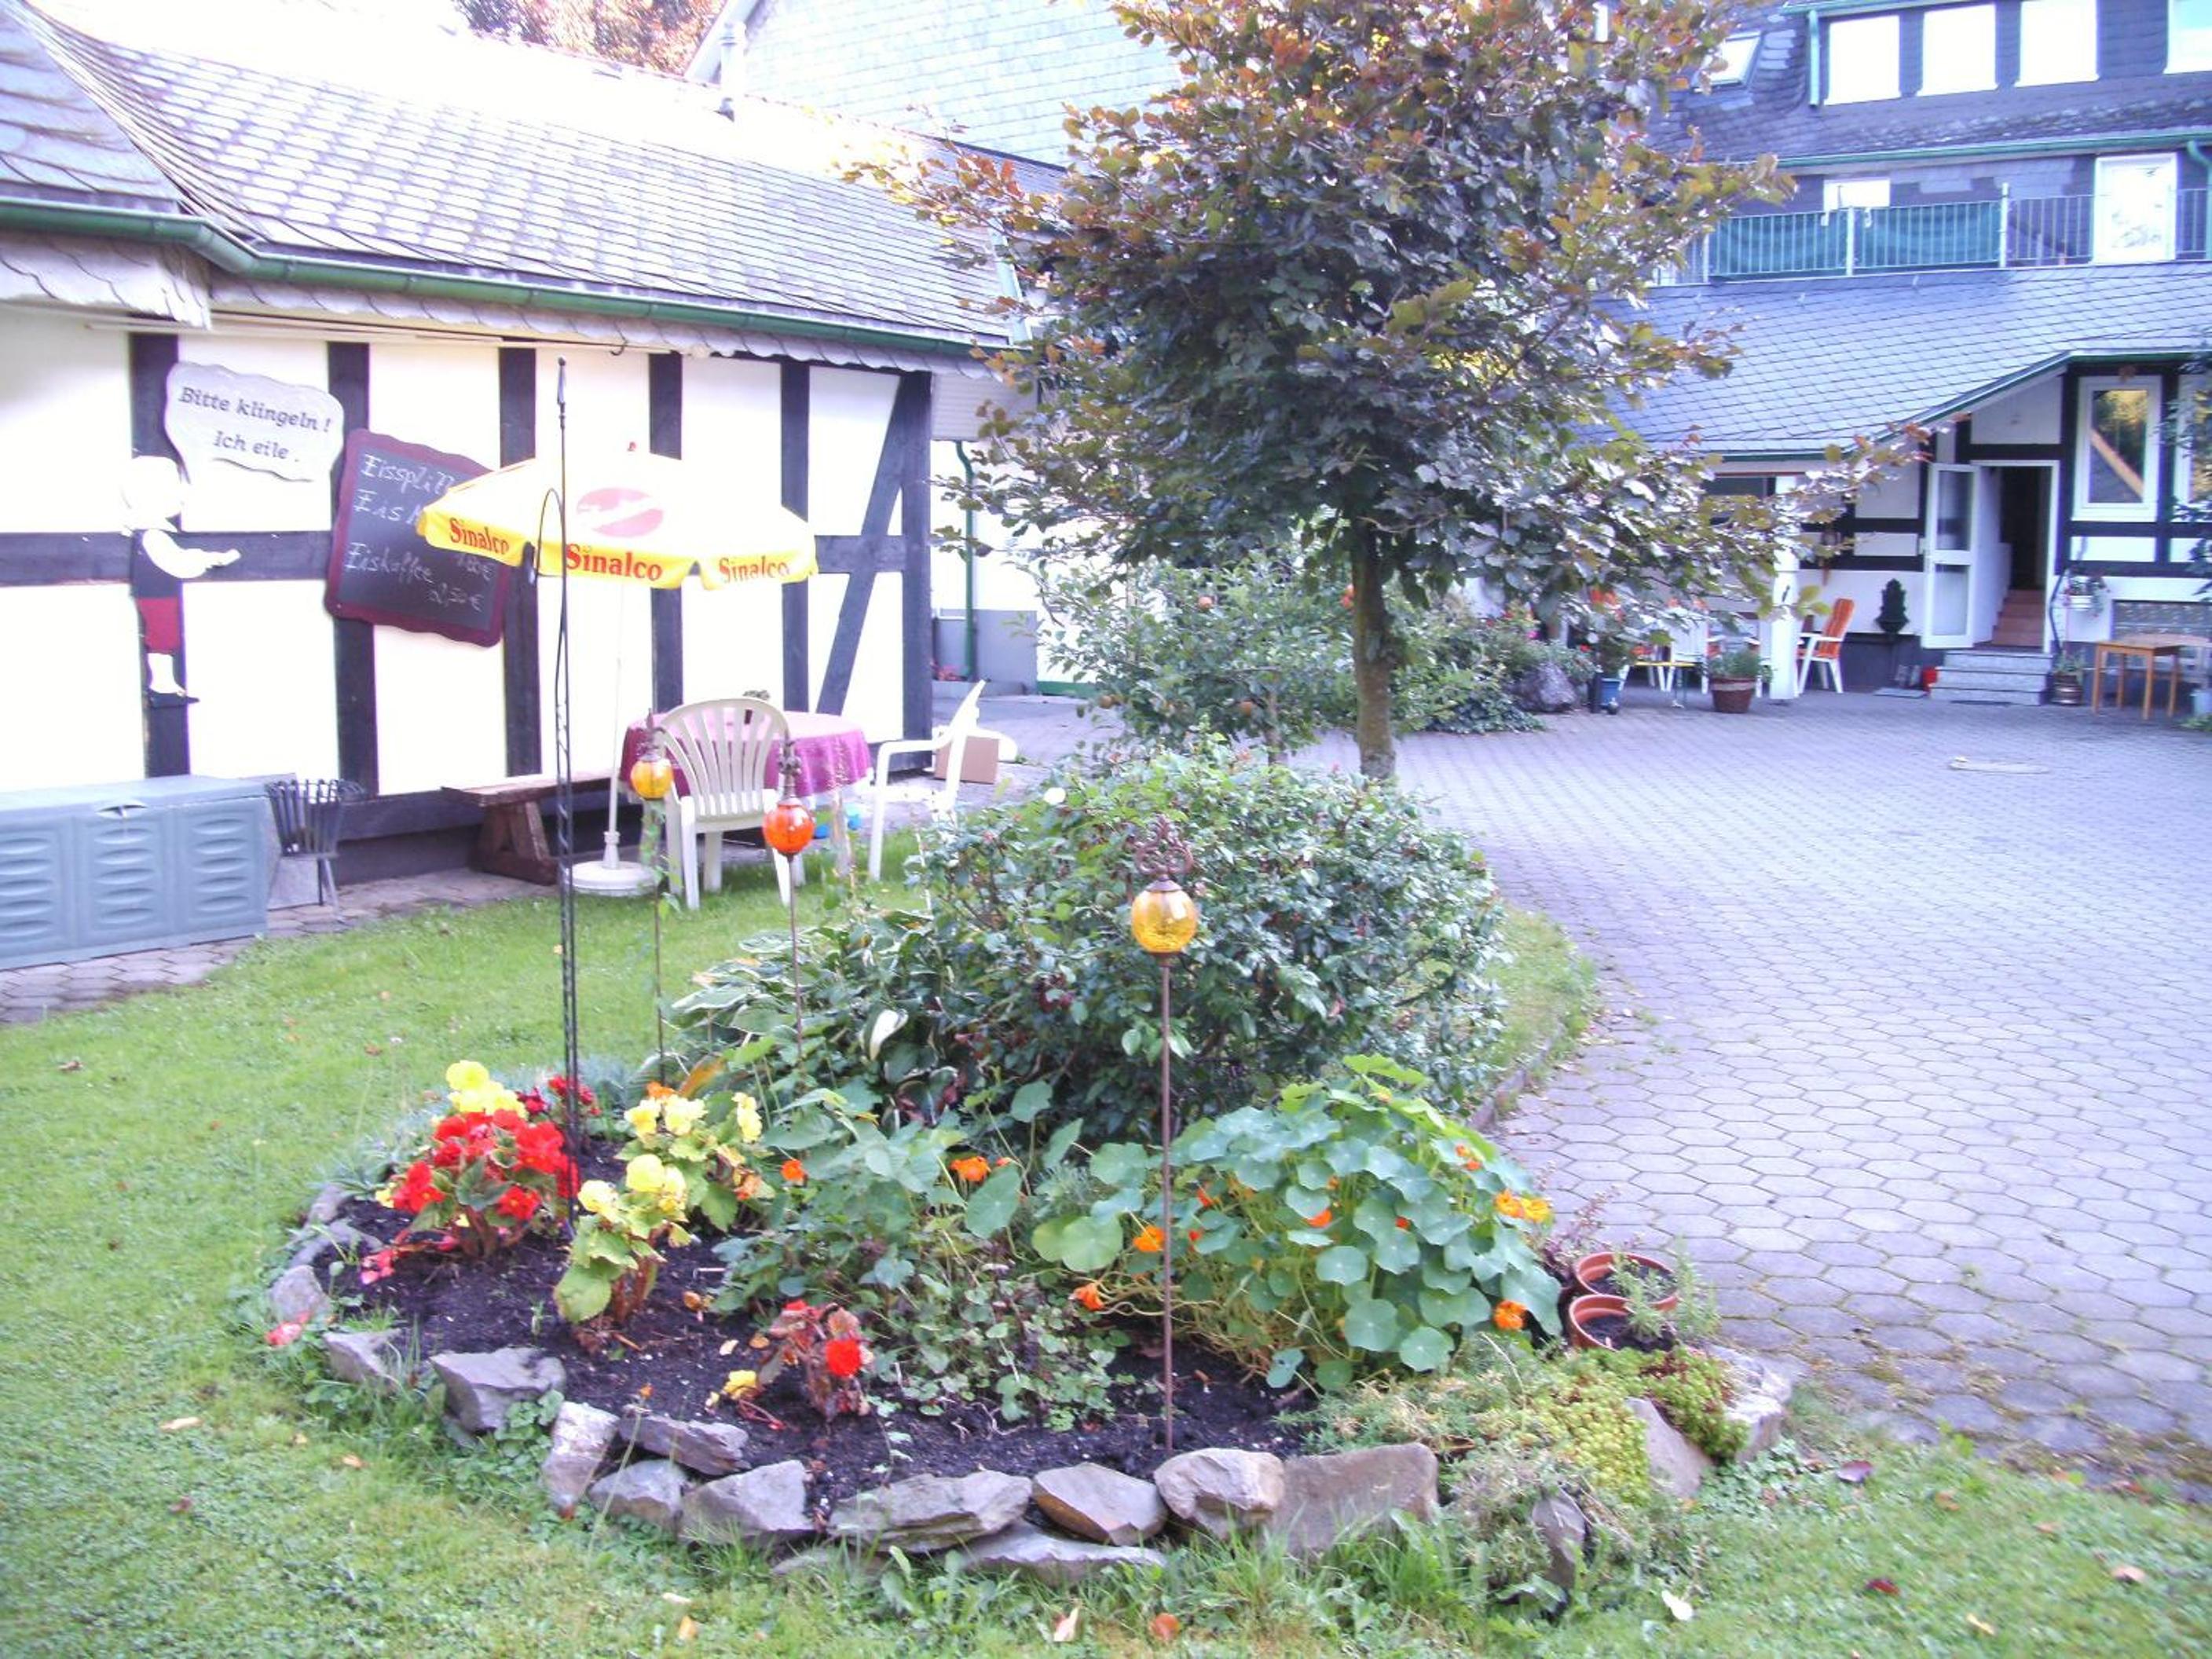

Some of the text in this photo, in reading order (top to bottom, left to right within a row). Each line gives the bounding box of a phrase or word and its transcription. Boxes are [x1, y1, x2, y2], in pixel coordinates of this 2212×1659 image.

[179, 387, 229, 411] Bitte
[236, 399, 317, 430] klingeln
[213, 430, 247, 452] Ich
[253, 441, 290, 460] eile
[449, 517, 509, 555] Sinalco
[566, 543, 663, 581] Sinalco
[719, 555, 790, 584] Sinalco
